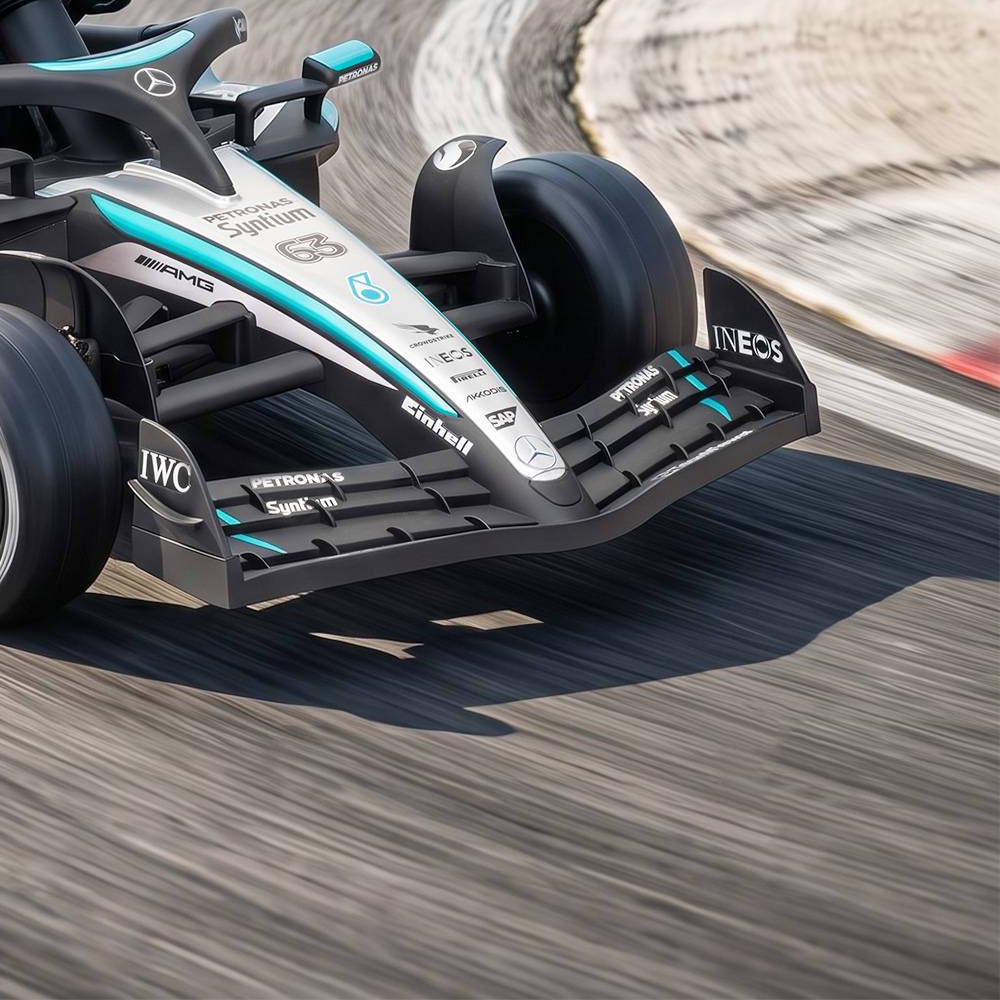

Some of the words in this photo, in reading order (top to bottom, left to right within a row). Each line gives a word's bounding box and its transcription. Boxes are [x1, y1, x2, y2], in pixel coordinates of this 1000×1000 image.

[338, 62, 379, 84] PETRONAS
[203, 198, 294, 224] PETRONAS
[216, 208, 317, 239] Syntium
[275, 232, 348, 264] 63
[159, 264, 215, 293] AMG
[424, 347, 474, 368] INEOS
[711, 325, 784, 364] INEOS
[401, 395, 475, 456] Einhell
[488, 410, 516, 428] SAP
[140, 449, 191, 493] IWC
